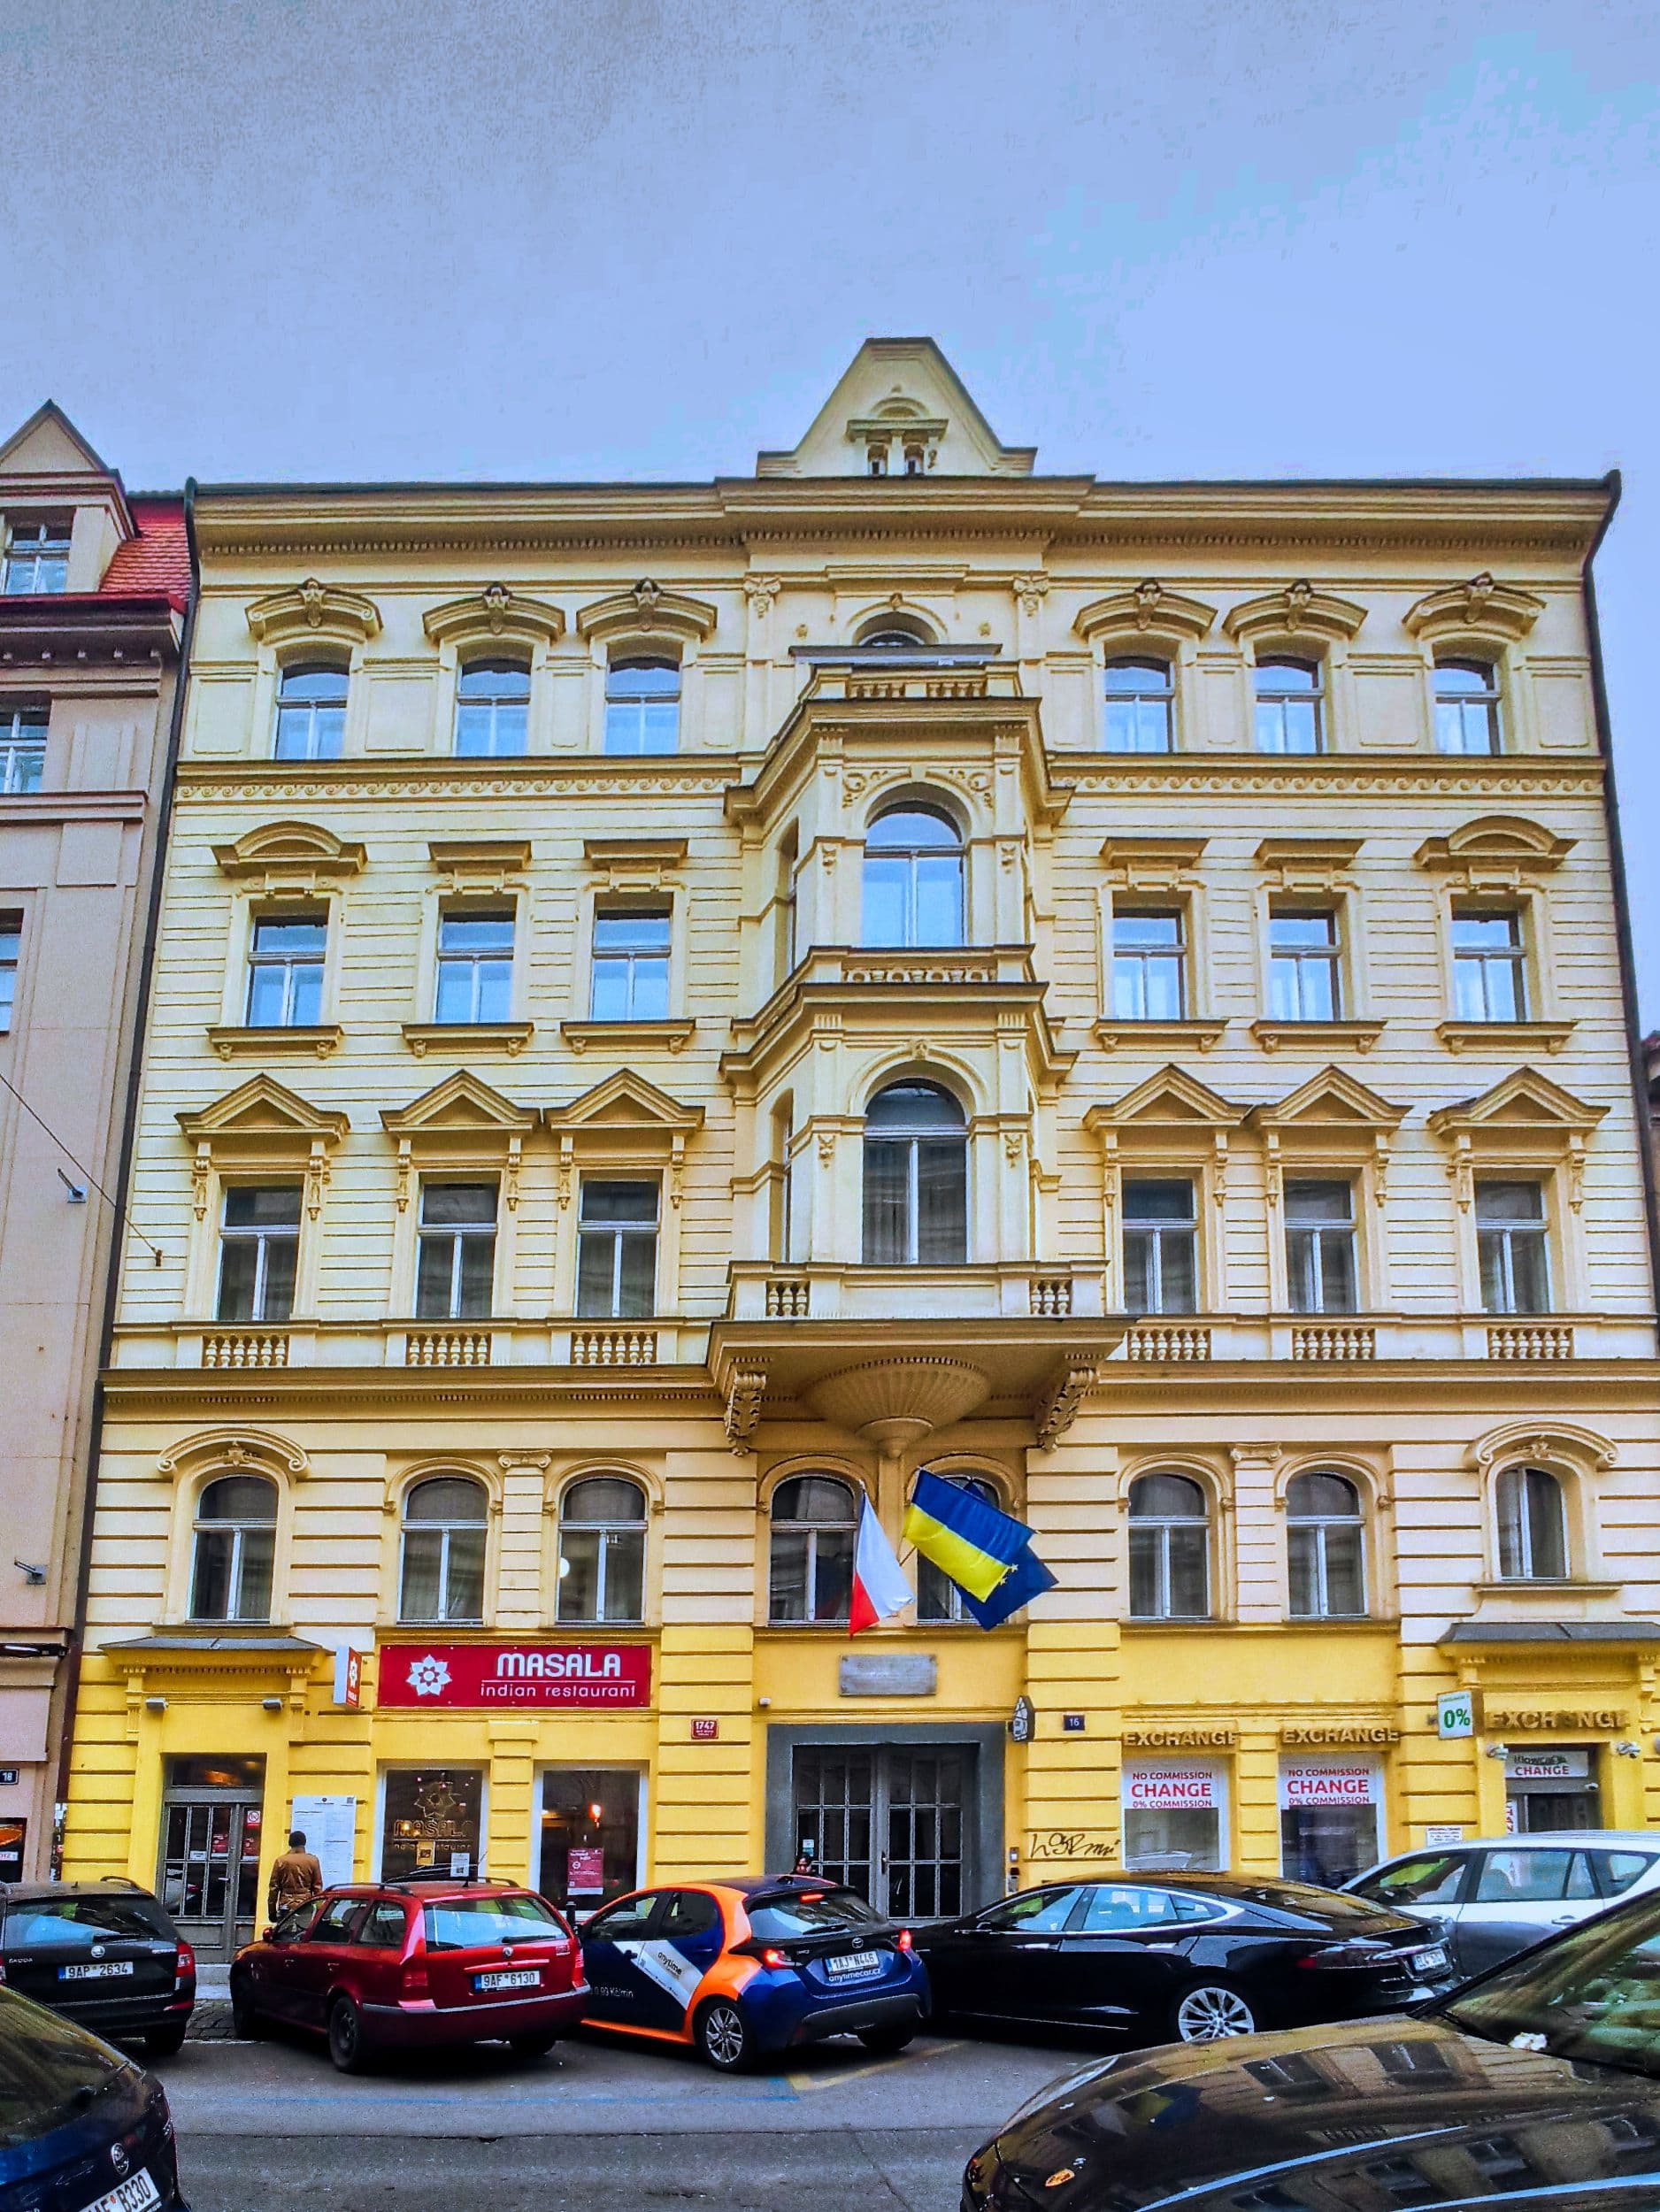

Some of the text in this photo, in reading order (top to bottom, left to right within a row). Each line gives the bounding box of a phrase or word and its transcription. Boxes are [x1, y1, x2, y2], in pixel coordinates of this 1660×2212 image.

[496, 1653, 621, 1677] MASALA
[480, 1684, 635, 1698] indian restaurant
[696, 1721, 715, 1730] 1747
[1069, 1717, 1080, 1726] 16
[1444, 1708, 1471, 1728] 0%
[1490, 1710, 1631, 1728] EXCHNGE
[1123, 1731, 1236, 1746] EXCHANGE
[1282, 1727, 1399, 1743] EXCHANGE
[2, 1772, 13, 1781] 18
[1149, 1771, 1212, 1780] COMMISSION
[1305, 1768, 1369, 1777] COMMISSION
[1514, 1765, 1570, 1776] CHANGE
[1131, 1783, 1211, 1798] CHANGE
[1287, 1779, 1369, 1794] CHANGE
[1149, 1800, 1212, 1809] COMMISSION
[1288, 1796, 1370, 1806] 0% COMMISSION
[68, 1962, 128, 1978] 9AP 2634
[657, 1952, 682, 1976] anytime
[483, 1972, 535, 1987] 9AF 6130
[116, 2175, 151, 2212] B330
